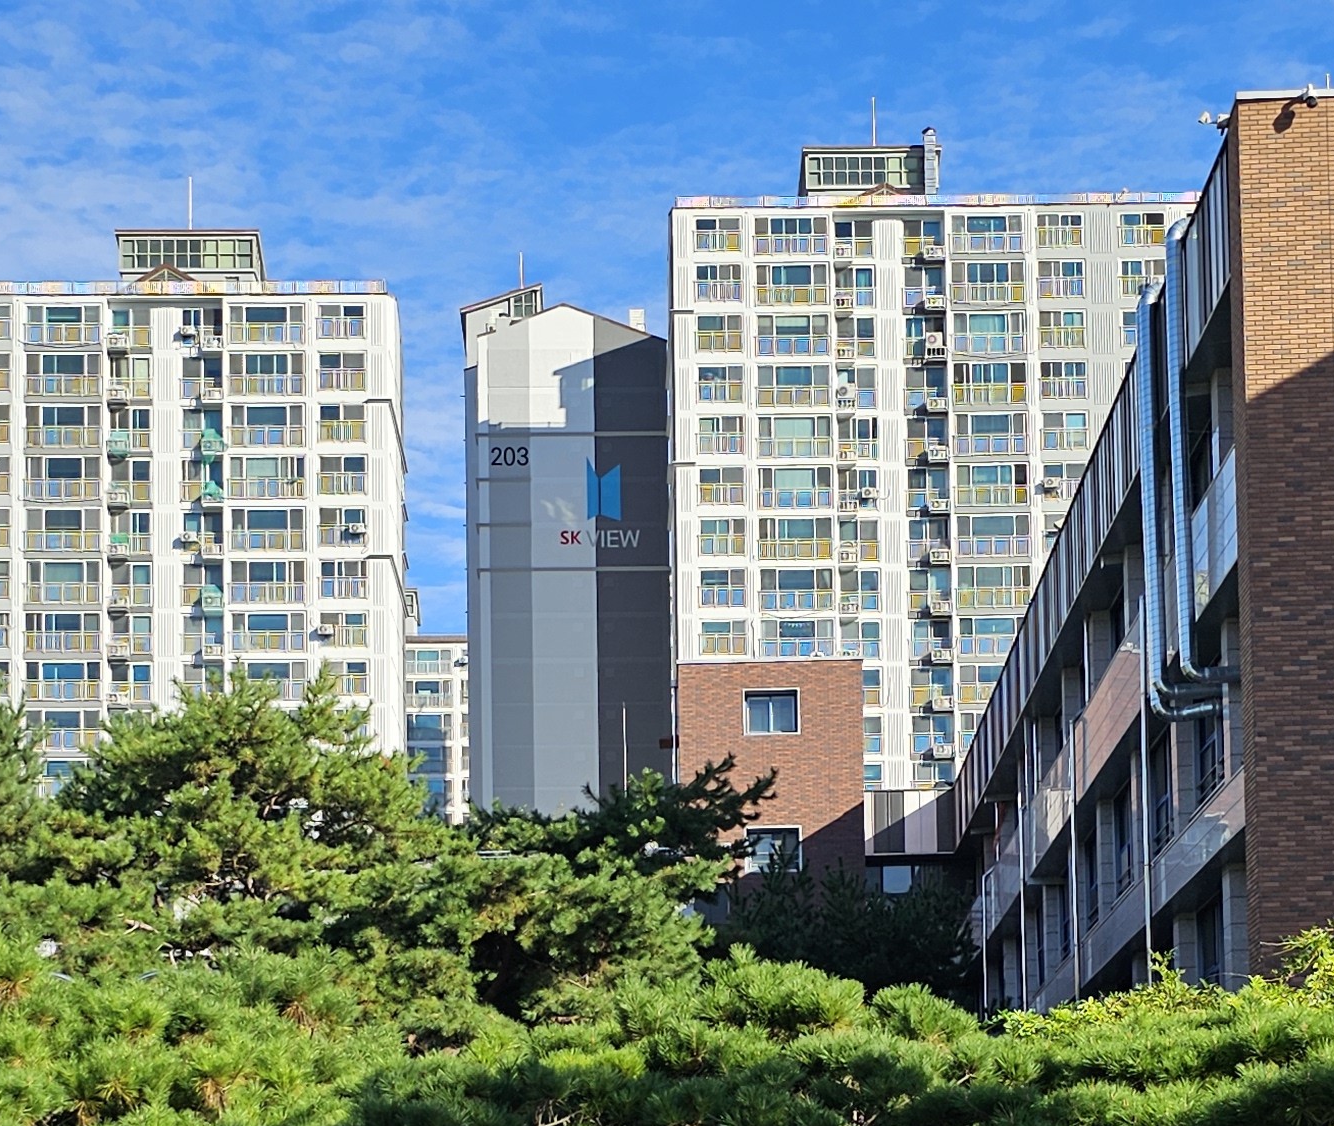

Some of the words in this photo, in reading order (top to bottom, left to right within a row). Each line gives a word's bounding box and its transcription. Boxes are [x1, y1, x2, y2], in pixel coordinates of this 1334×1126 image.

[491, 446, 529, 466] 203
[560, 530, 582, 545] SK
[586, 529, 640, 548] VIEW
